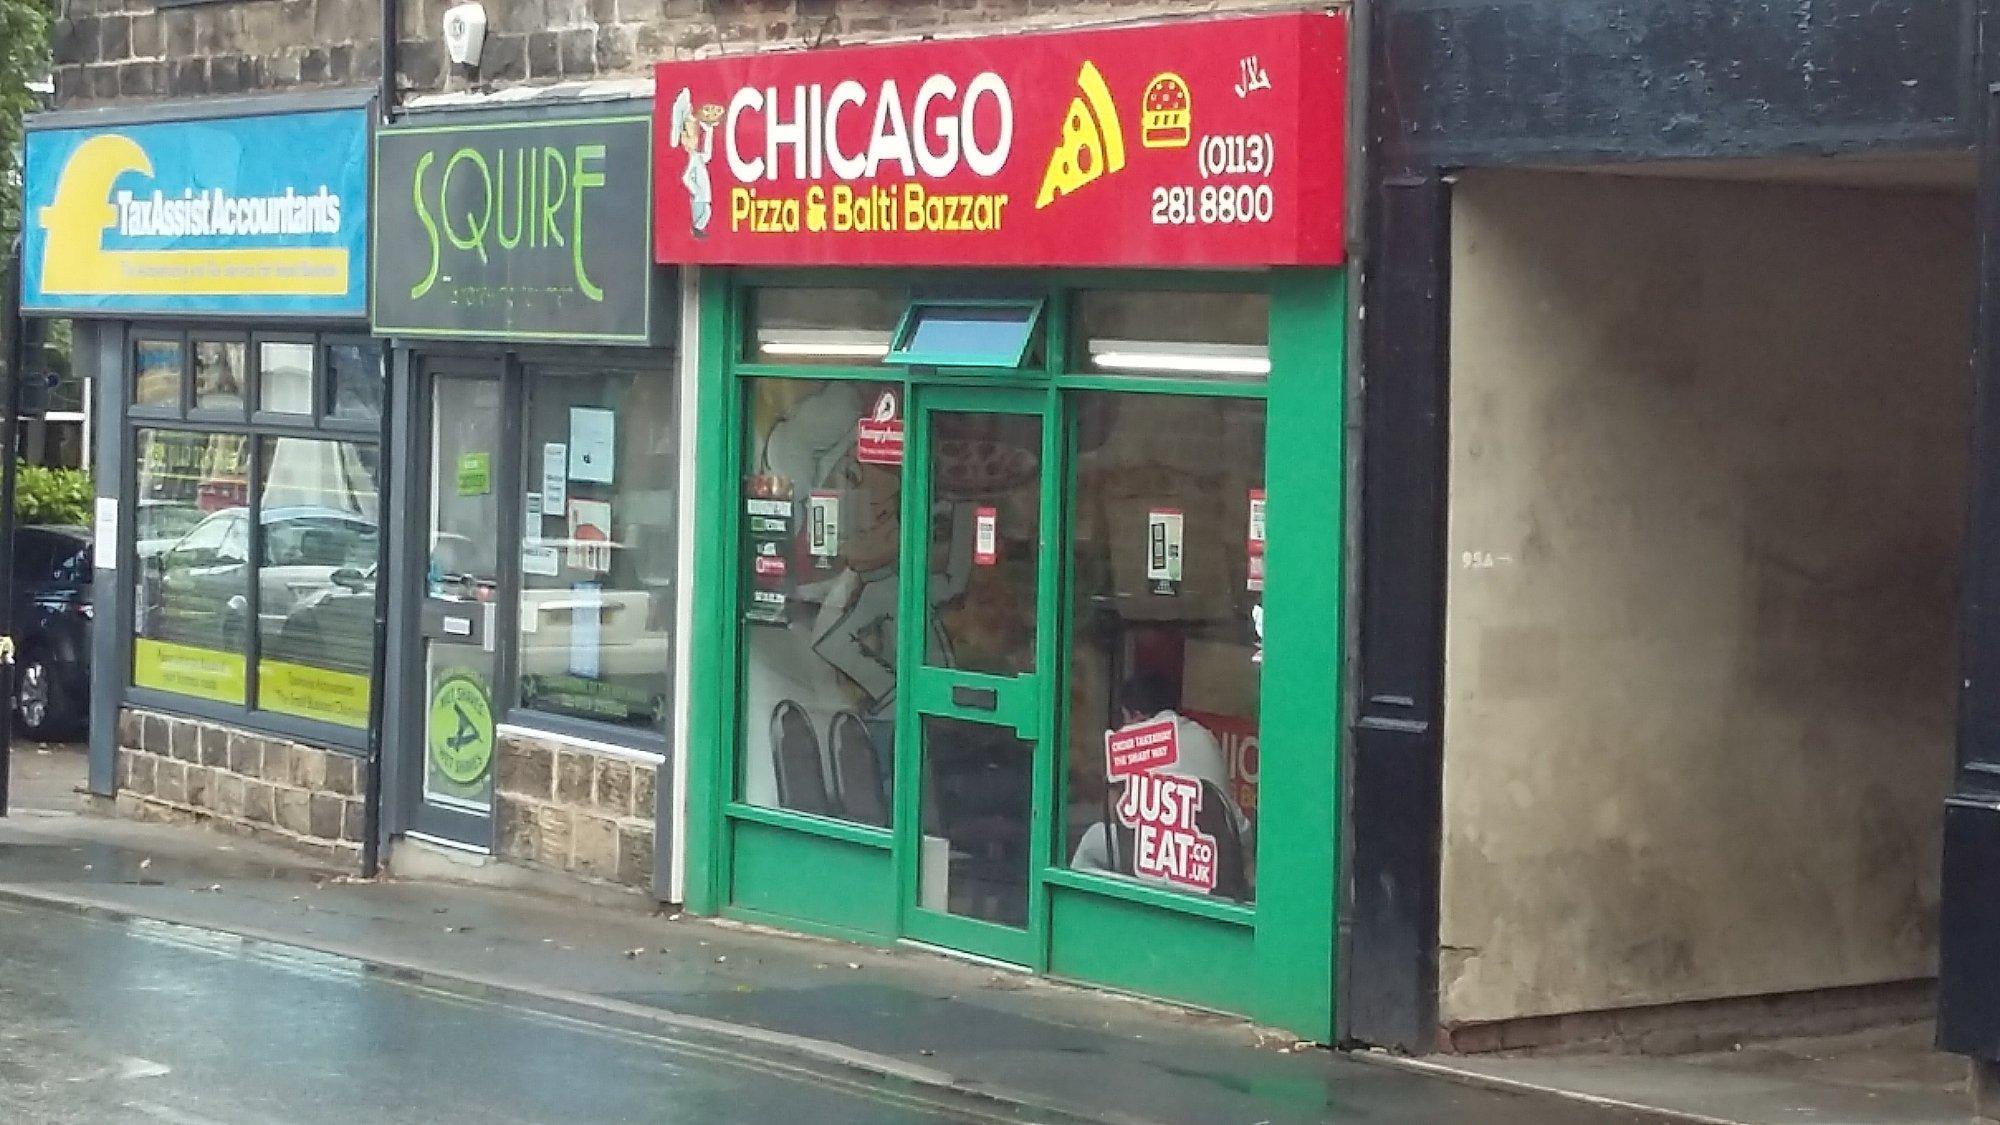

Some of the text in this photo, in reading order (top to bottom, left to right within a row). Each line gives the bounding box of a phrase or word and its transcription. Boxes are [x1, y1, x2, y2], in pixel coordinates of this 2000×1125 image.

[724, 72, 1014, 183] CHICAGO
[1198, 132, 1275, 180] (0113)
[117, 185, 341, 236] TaxAssist Accountants
[411, 145, 607, 301] SQUIRE
[731, 182, 1009, 233] Pizza & Balti Bazzar
[1152, 184, 1274, 225] 281 8800
[1124, 774, 1197, 830] JUST
[1140, 824, 1196, 878] EAT
